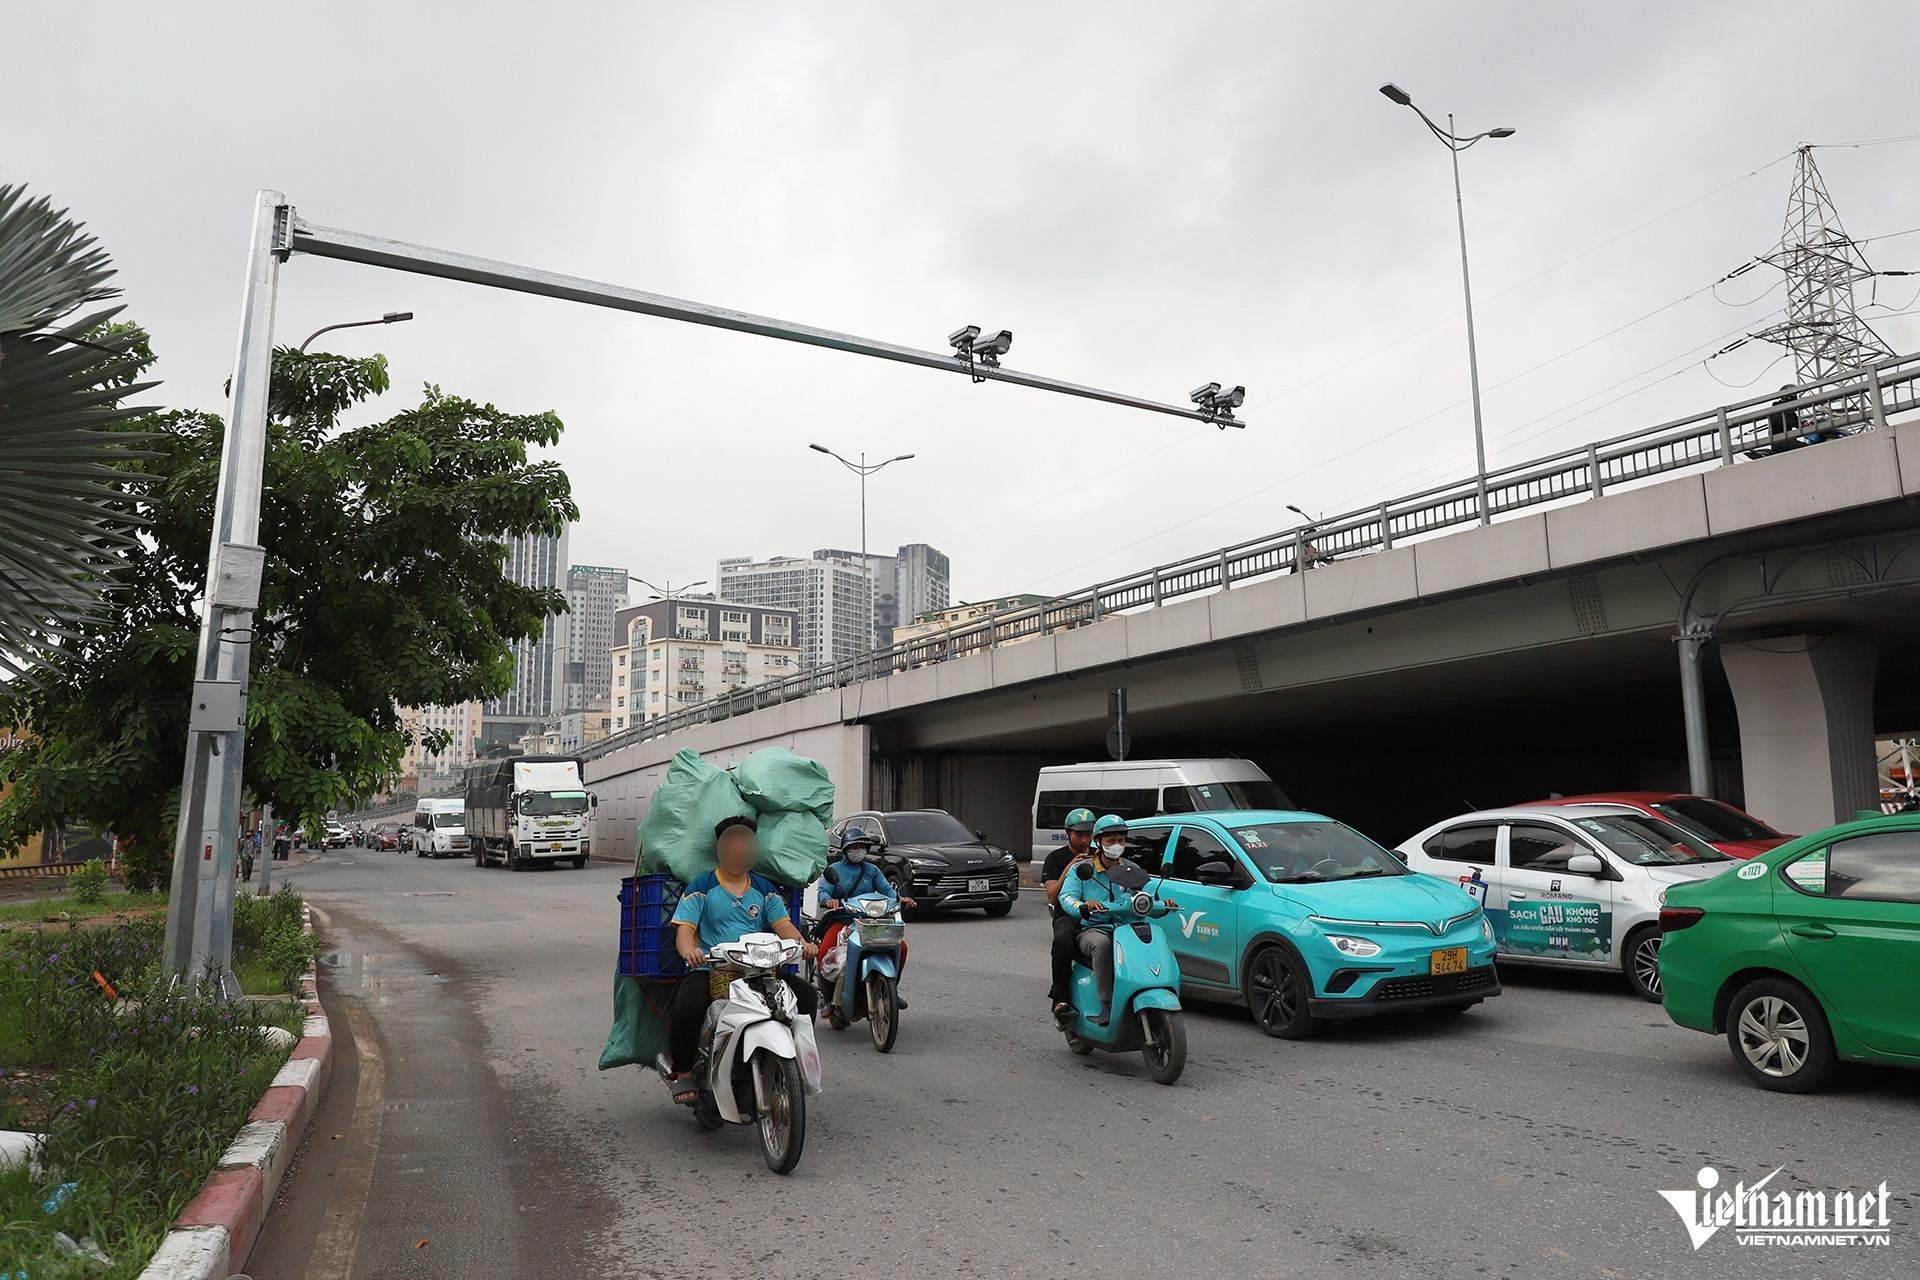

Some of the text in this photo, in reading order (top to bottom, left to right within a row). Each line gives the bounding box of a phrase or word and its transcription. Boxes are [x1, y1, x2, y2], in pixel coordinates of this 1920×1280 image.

[1748, 865, 1762, 876] 1121
[1509, 910, 1537, 921] SẠCH
[1566, 906, 1599, 917] KHÔNG
[1196, 925, 1219, 937] XANH SM
[1442, 949, 1458, 961] 29H
[1435, 960, 1463, 974] 944.74
